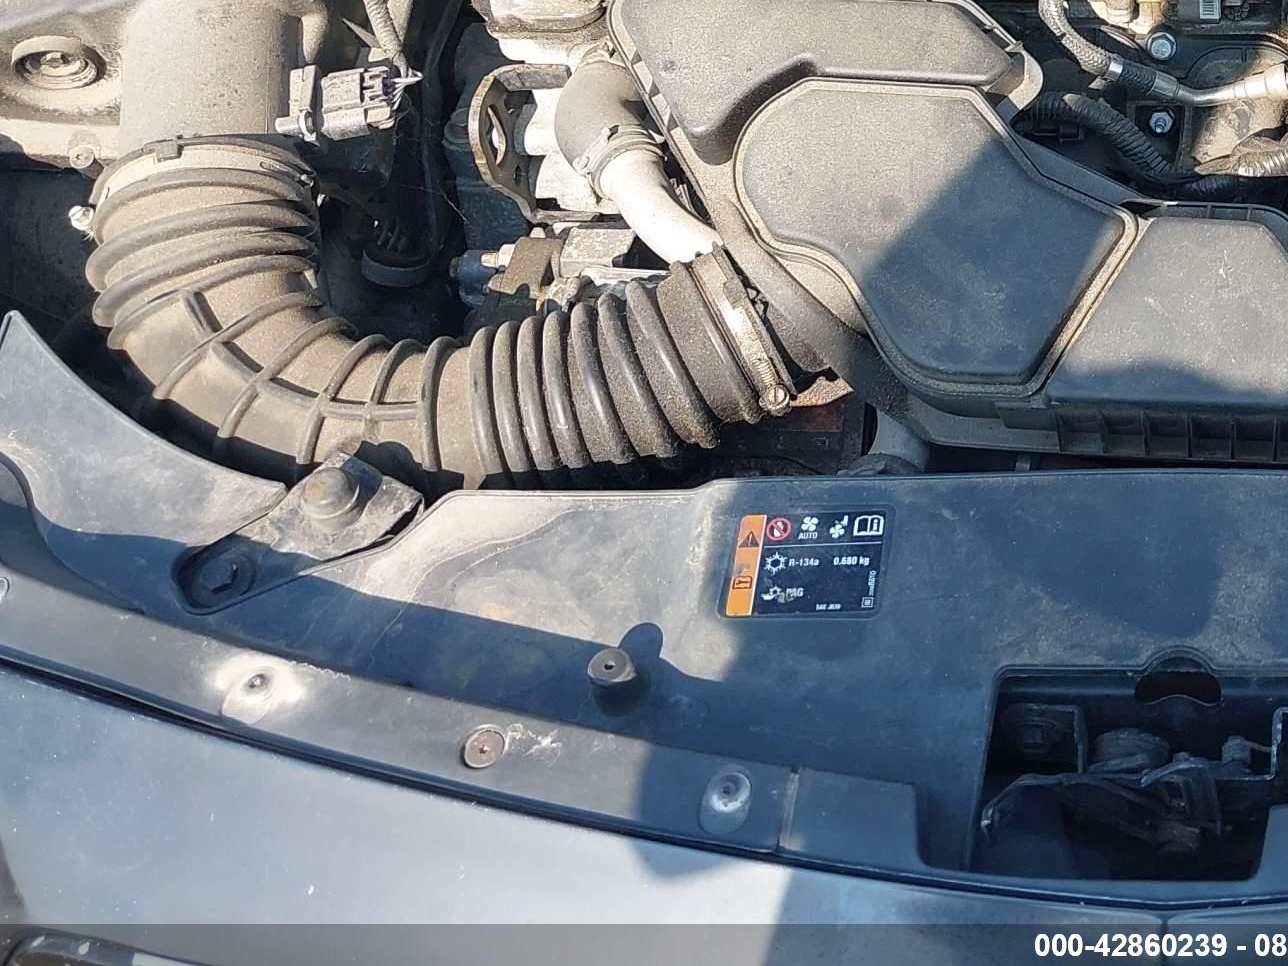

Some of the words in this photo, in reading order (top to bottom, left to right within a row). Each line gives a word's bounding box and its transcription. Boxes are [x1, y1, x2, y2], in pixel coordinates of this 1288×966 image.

[798, 532, 819, 540] AUTO
[789, 558, 819, 567] R-134a
[859, 556, 870, 566] kg
[786, 588, 804, 597] PAG
